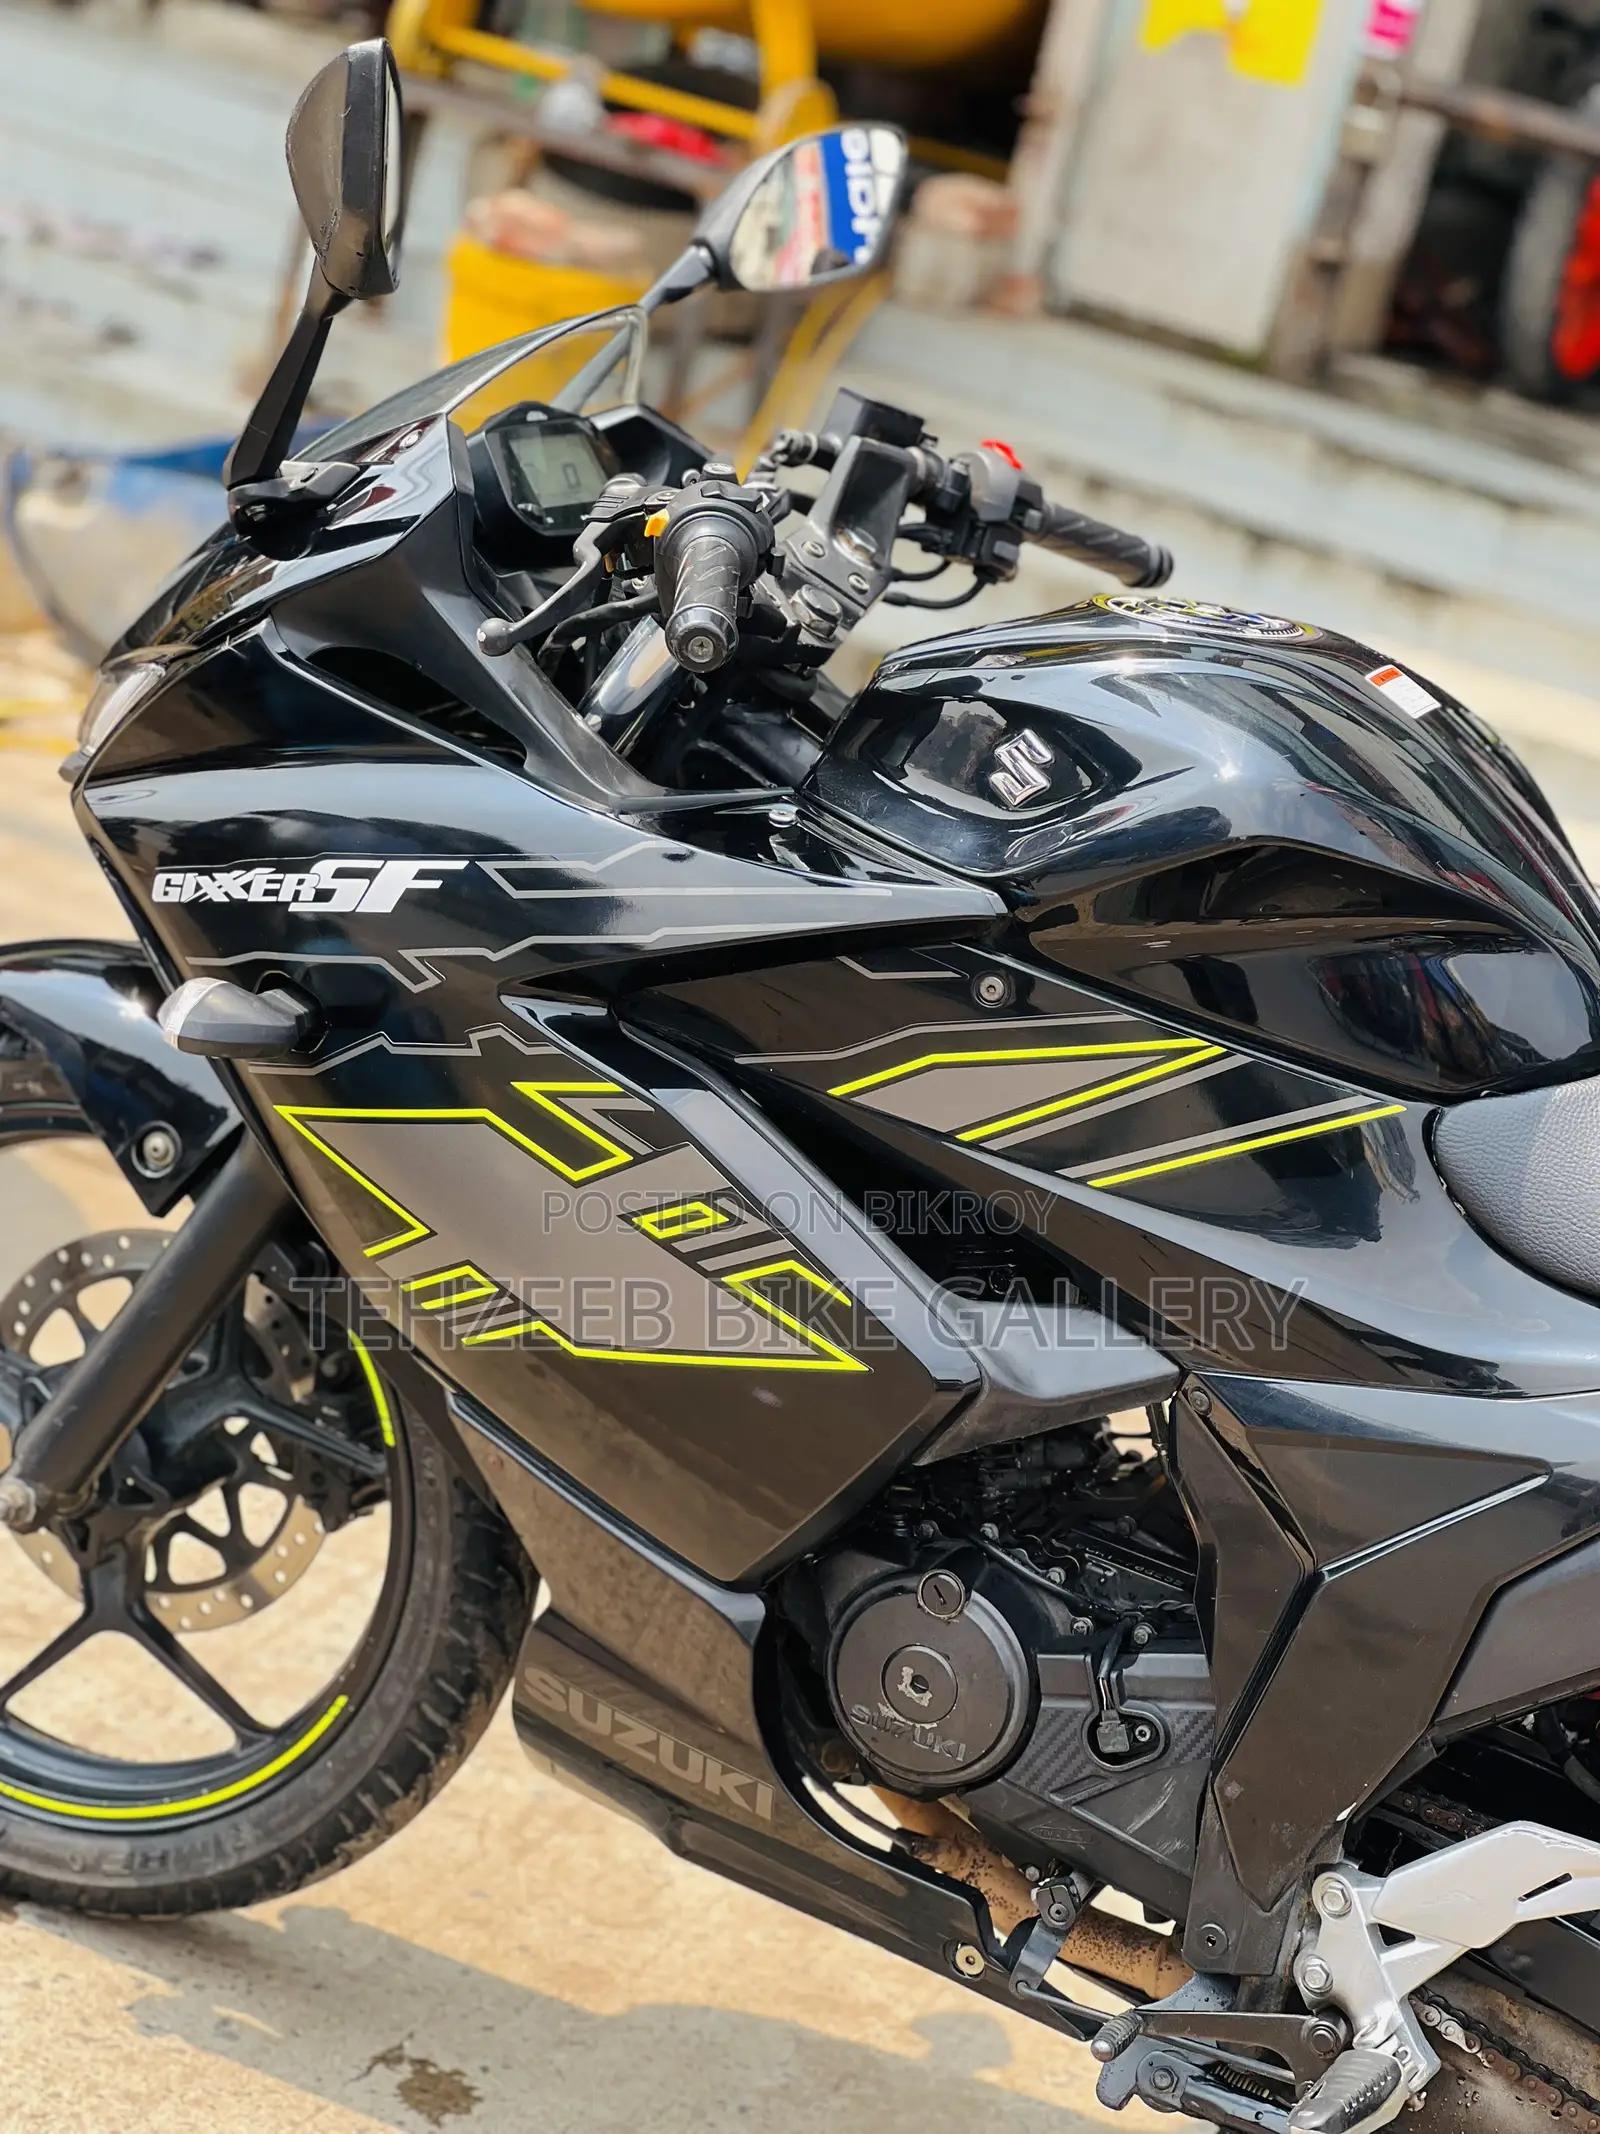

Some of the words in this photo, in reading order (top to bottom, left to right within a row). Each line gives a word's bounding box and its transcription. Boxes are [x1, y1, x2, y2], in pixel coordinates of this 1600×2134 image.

[152, 867, 320, 903] GIXXER
[287, 859, 470, 913] SF
[524, 1666, 774, 1821] SUZUKI
[850, 1703, 967, 1762] SUZUKI
